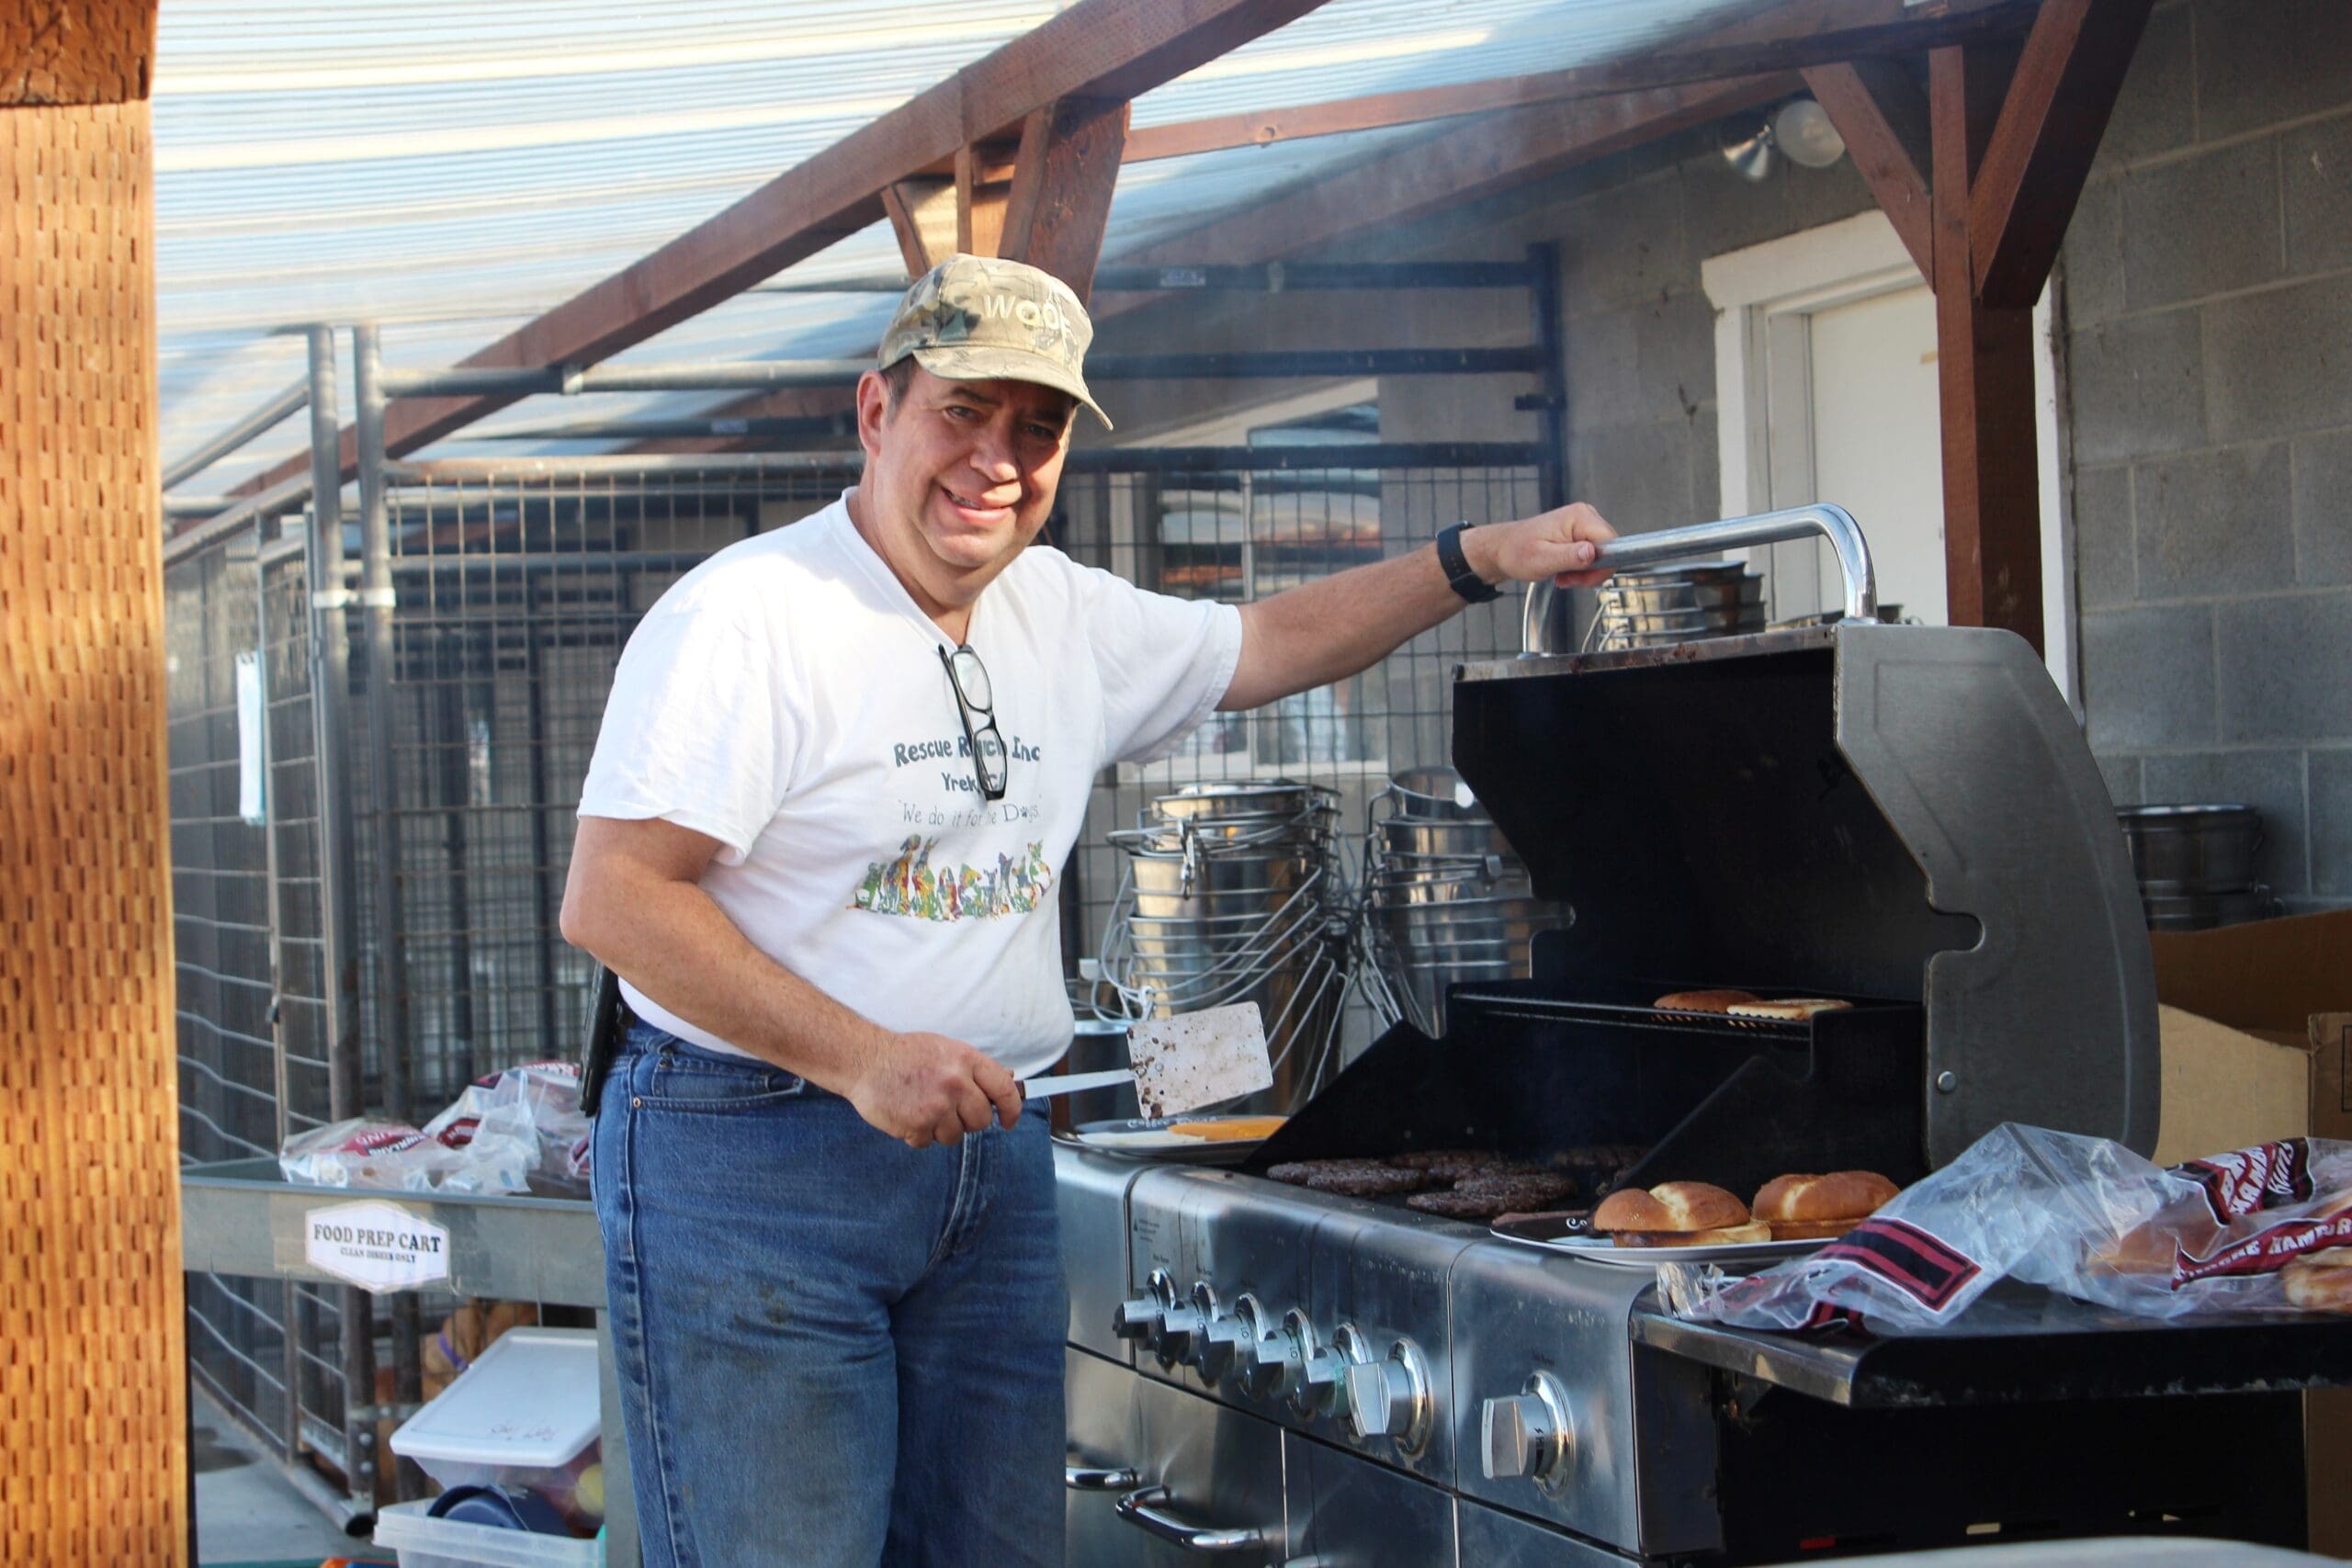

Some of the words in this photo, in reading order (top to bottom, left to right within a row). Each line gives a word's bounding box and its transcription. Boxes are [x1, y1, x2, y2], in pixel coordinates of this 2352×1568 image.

[893, 740, 954, 768] Rescue
[1012, 736, 1041, 761] Inc
[929, 806, 944, 826] do
[952, 811, 963, 828] it
[965, 809, 982, 828] for
[313, 1224, 353, 1243] FOOD
[356, 1227, 395, 1247] PREP
[399, 1233, 441, 1253] CART
[340, 1247, 365, 1258] CLEAN
[366, 1250, 393, 1261] DISHES
[395, 1254, 416, 1264] ONLY
